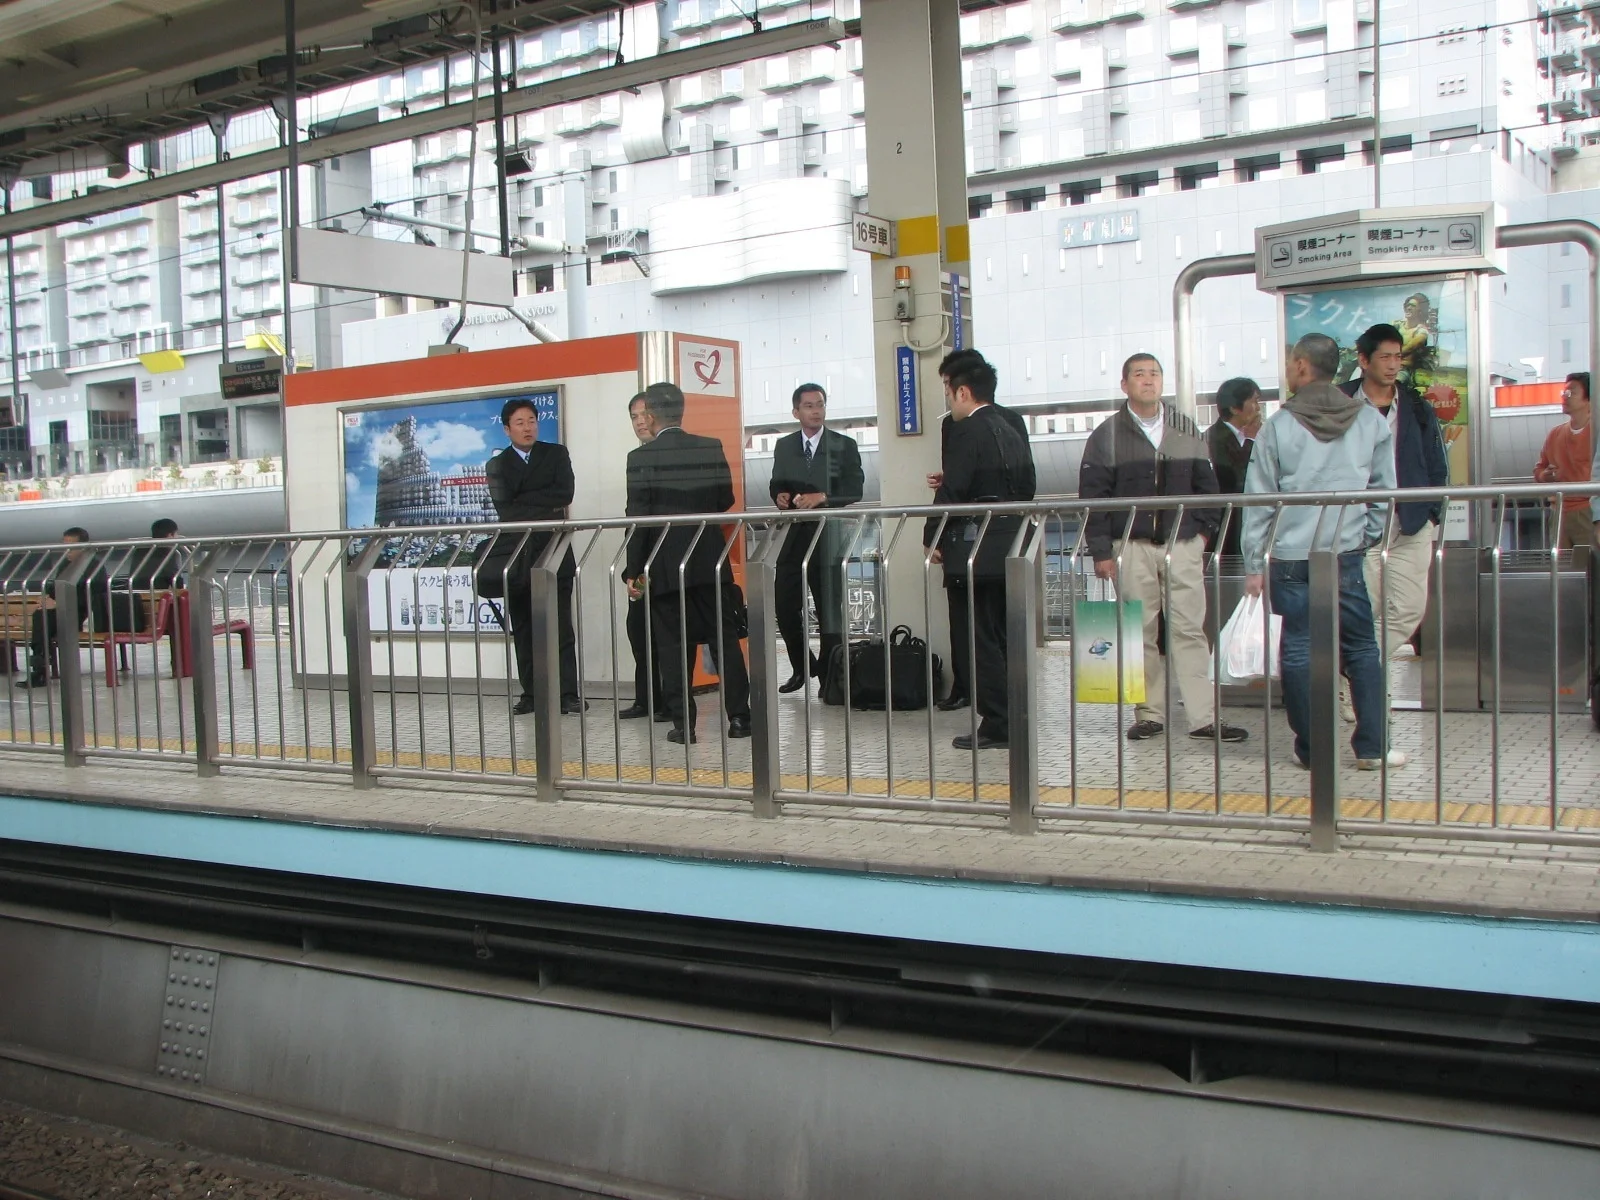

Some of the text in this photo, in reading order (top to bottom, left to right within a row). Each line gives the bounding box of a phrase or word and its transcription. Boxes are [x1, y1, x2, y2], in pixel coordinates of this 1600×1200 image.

[896, 142, 902, 154] 2
[856, 221, 888, 246] 16号車
[1367, 227, 1440, 241] 喫煙コーナー
[1297, 233, 1356, 251] 喫煙コーナー
[1368, 243, 1435, 255] Smoking Area
[1298, 250, 1352, 264] Smoking Area
[463, 314, 485, 327] OTEL
[902, 357, 911, 421] 緊急停止スイッチ
